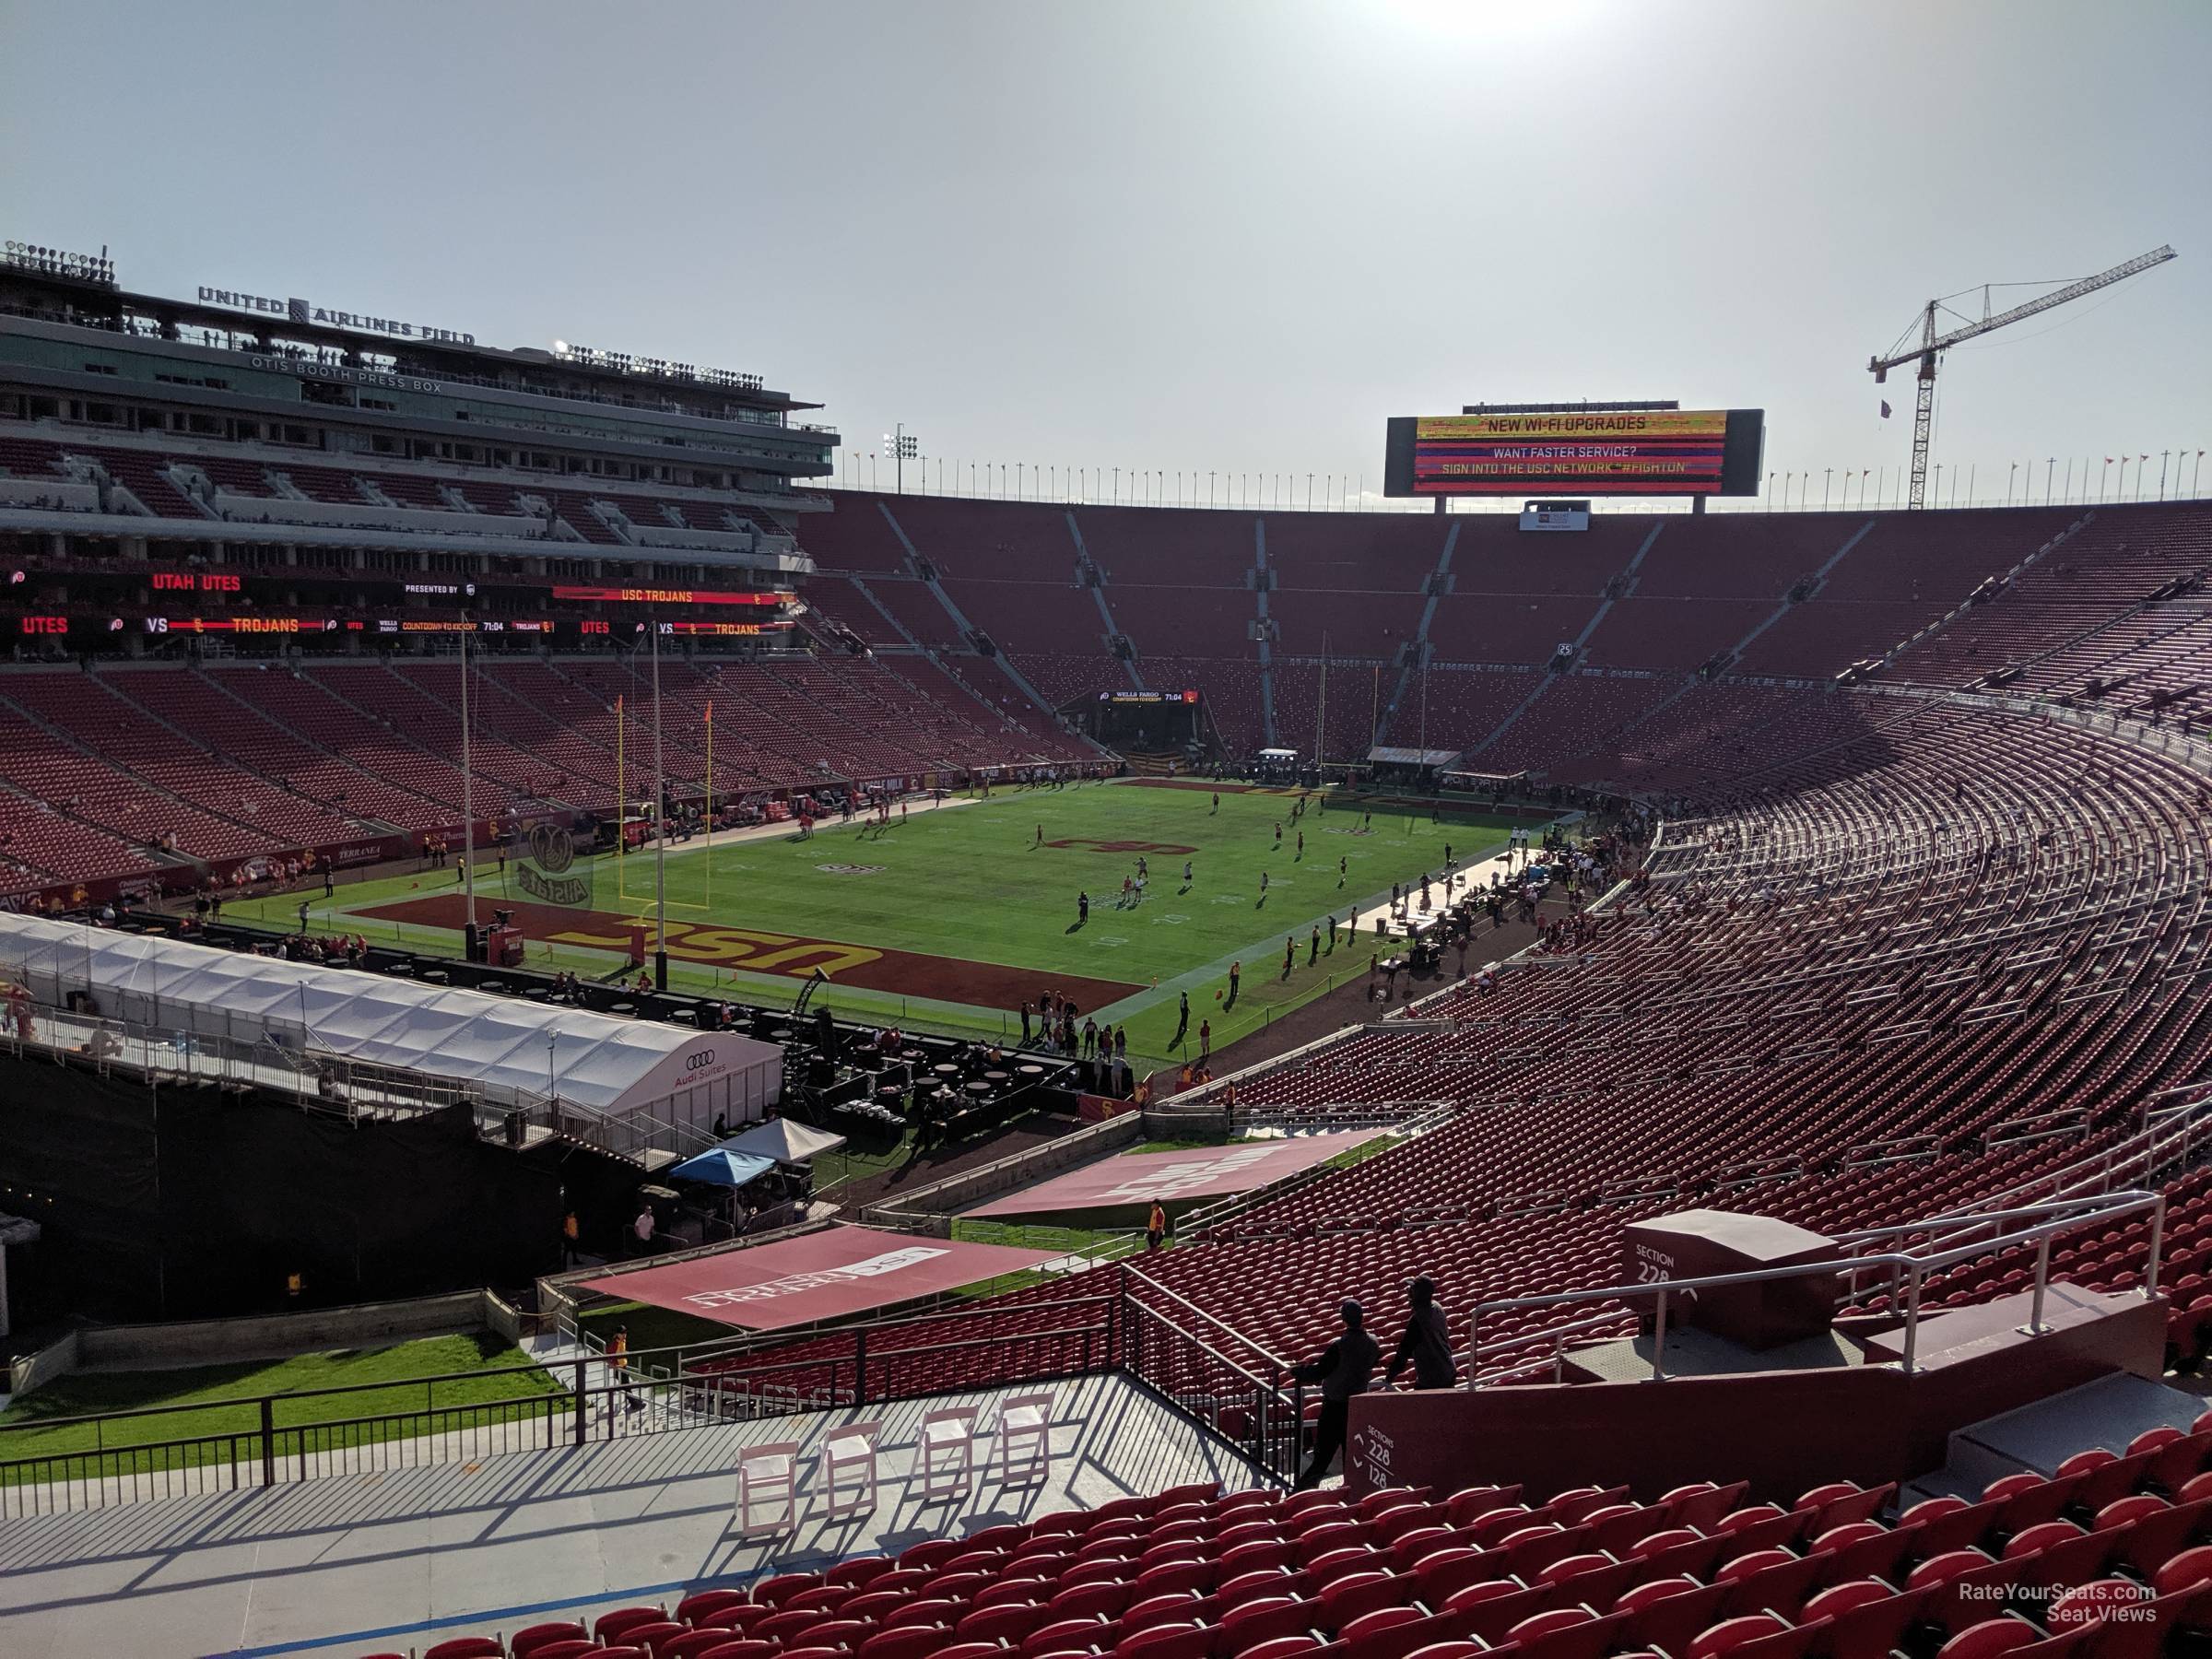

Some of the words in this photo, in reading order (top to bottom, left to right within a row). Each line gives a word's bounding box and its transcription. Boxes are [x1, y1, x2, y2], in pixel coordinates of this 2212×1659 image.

[198, 286, 284, 313] UNITED
[314, 308, 412, 336] AIRLINES
[422, 326, 475, 347] FIELD
[252, 357, 288, 371] OTIS
[297, 363, 350, 381] BOOTH
[359, 372, 406, 388] PRESS
[413, 380, 442, 393] BOX
[1488, 420, 1521, 432] NEW
[1525, 418, 1560, 431] WI-FI
[1566, 417, 1646, 430] UPGRADES
[1493, 447, 1526, 459] WANT
[1530, 447, 1575, 458] FASTER
[1579, 446, 1637, 457] SERVICE?
[1442, 464, 1469, 474] SIGN
[1472, 464, 1498, 474] INTO
[1503, 464, 1524, 474] THE
[1527, 464, 1550, 474] USC
[1553, 463, 1612, 474] NETWORK
[153, 573, 194, 590] UTAH
[202, 575, 241, 591] UTES
[406, 584, 447, 594] PRESENTED
[449, 585, 458, 594] BY
[621, 589, 642, 601] USC
[645, 590, 692, 603] TROJANS
[22, 617, 68, 633] UTES
[147, 618, 168, 633] VS
[232, 618, 299, 633] TROJANS
[484, 621, 504, 631] 71:04
[581, 621, 610, 634] UTES
[660, 623, 673, 633] VS
[715, 623, 760, 635] TROJANS
[675, 1071, 697, 1088] Audi
[699, 1064, 727, 1079] Suites
[850, 1249, 935, 1274] USC
[1636, 1243, 1675, 1267] SECTION
[1368, 1424, 1394, 1449] SECTIONS
[1369, 1439, 1391, 1466] 228
[1369, 1464, 1387, 1489] 128
